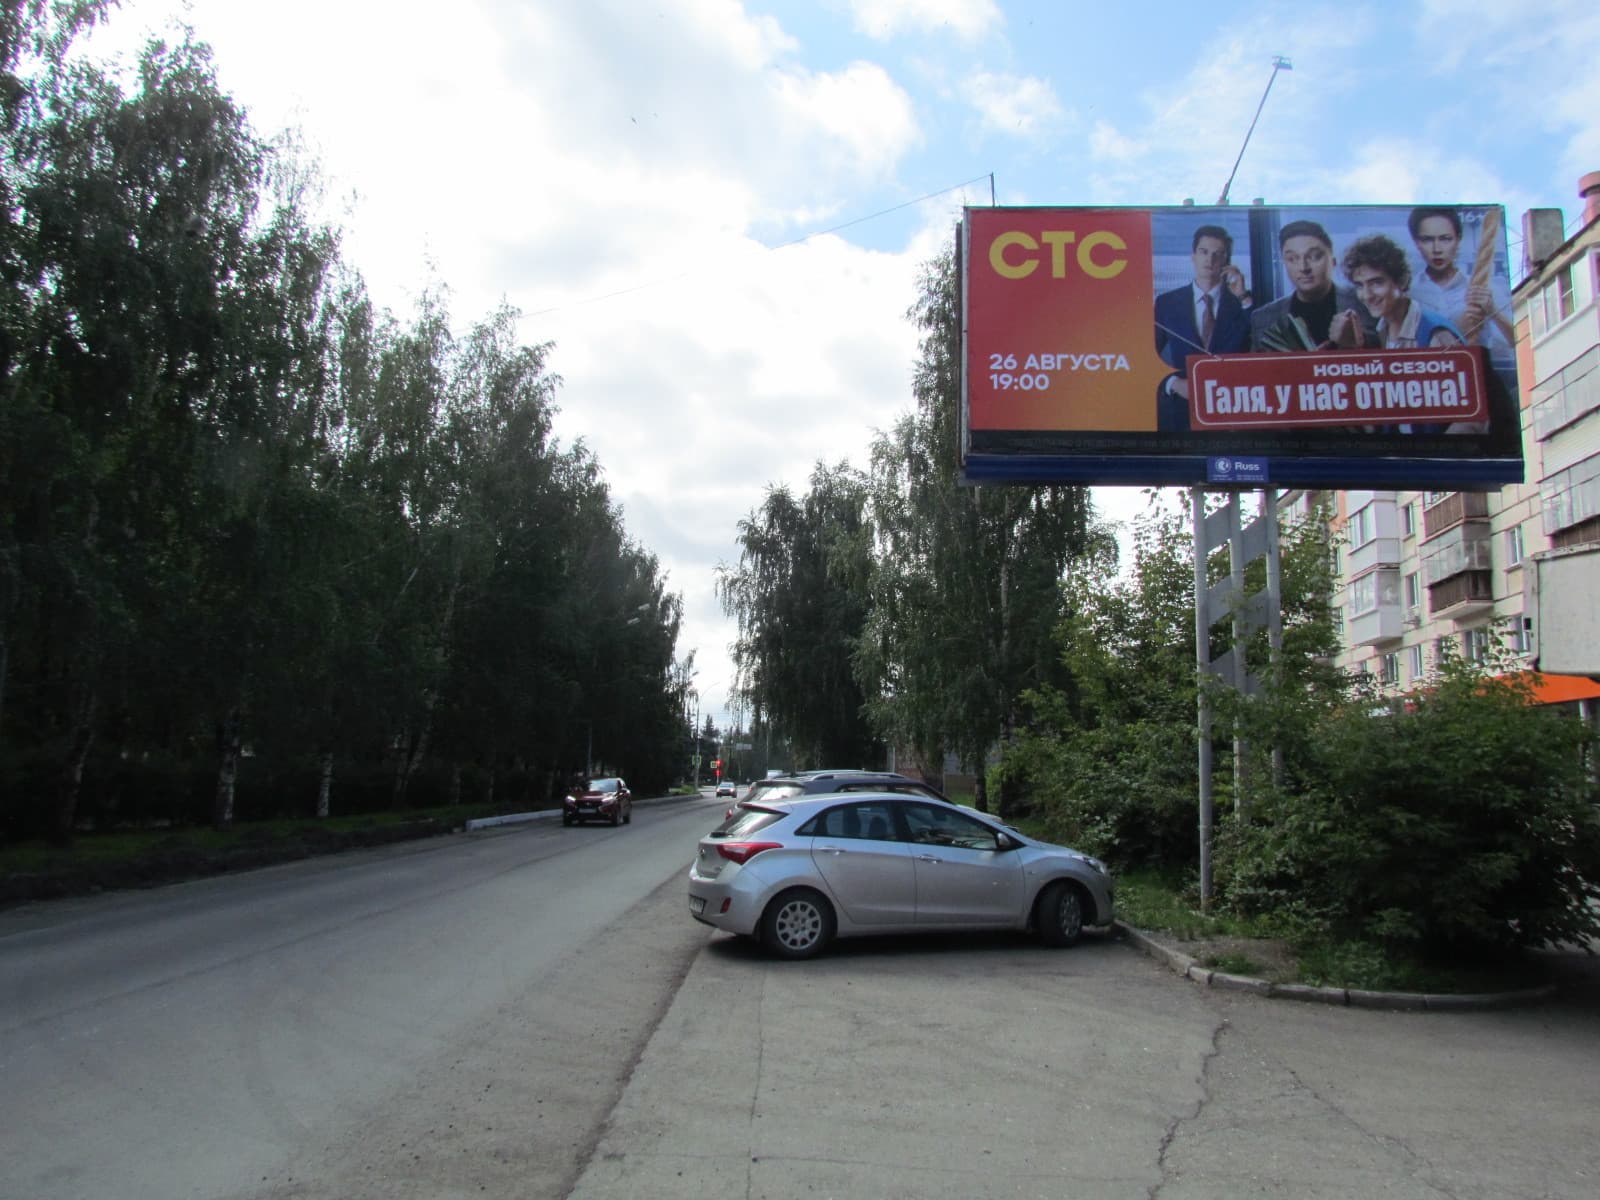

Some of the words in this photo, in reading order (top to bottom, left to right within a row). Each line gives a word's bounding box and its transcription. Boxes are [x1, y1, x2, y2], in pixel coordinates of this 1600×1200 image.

[989, 231, 1128, 279] СТС
[989, 354, 1018, 370] 26
[1024, 354, 1130, 371] АВГУСТА
[1313, 360, 1384, 377] НОВЫЙ
[1389, 360, 1455, 374] СЕЗОН
[989, 374, 1050, 390] 19:00
[1204, 379, 1273, 414] Галя,
[1275, 384, 1291, 414] у
[1298, 382, 1348, 411] нас
[1355, 371, 1468, 409] отмена!
[1234, 461, 1260, 471] Russ
